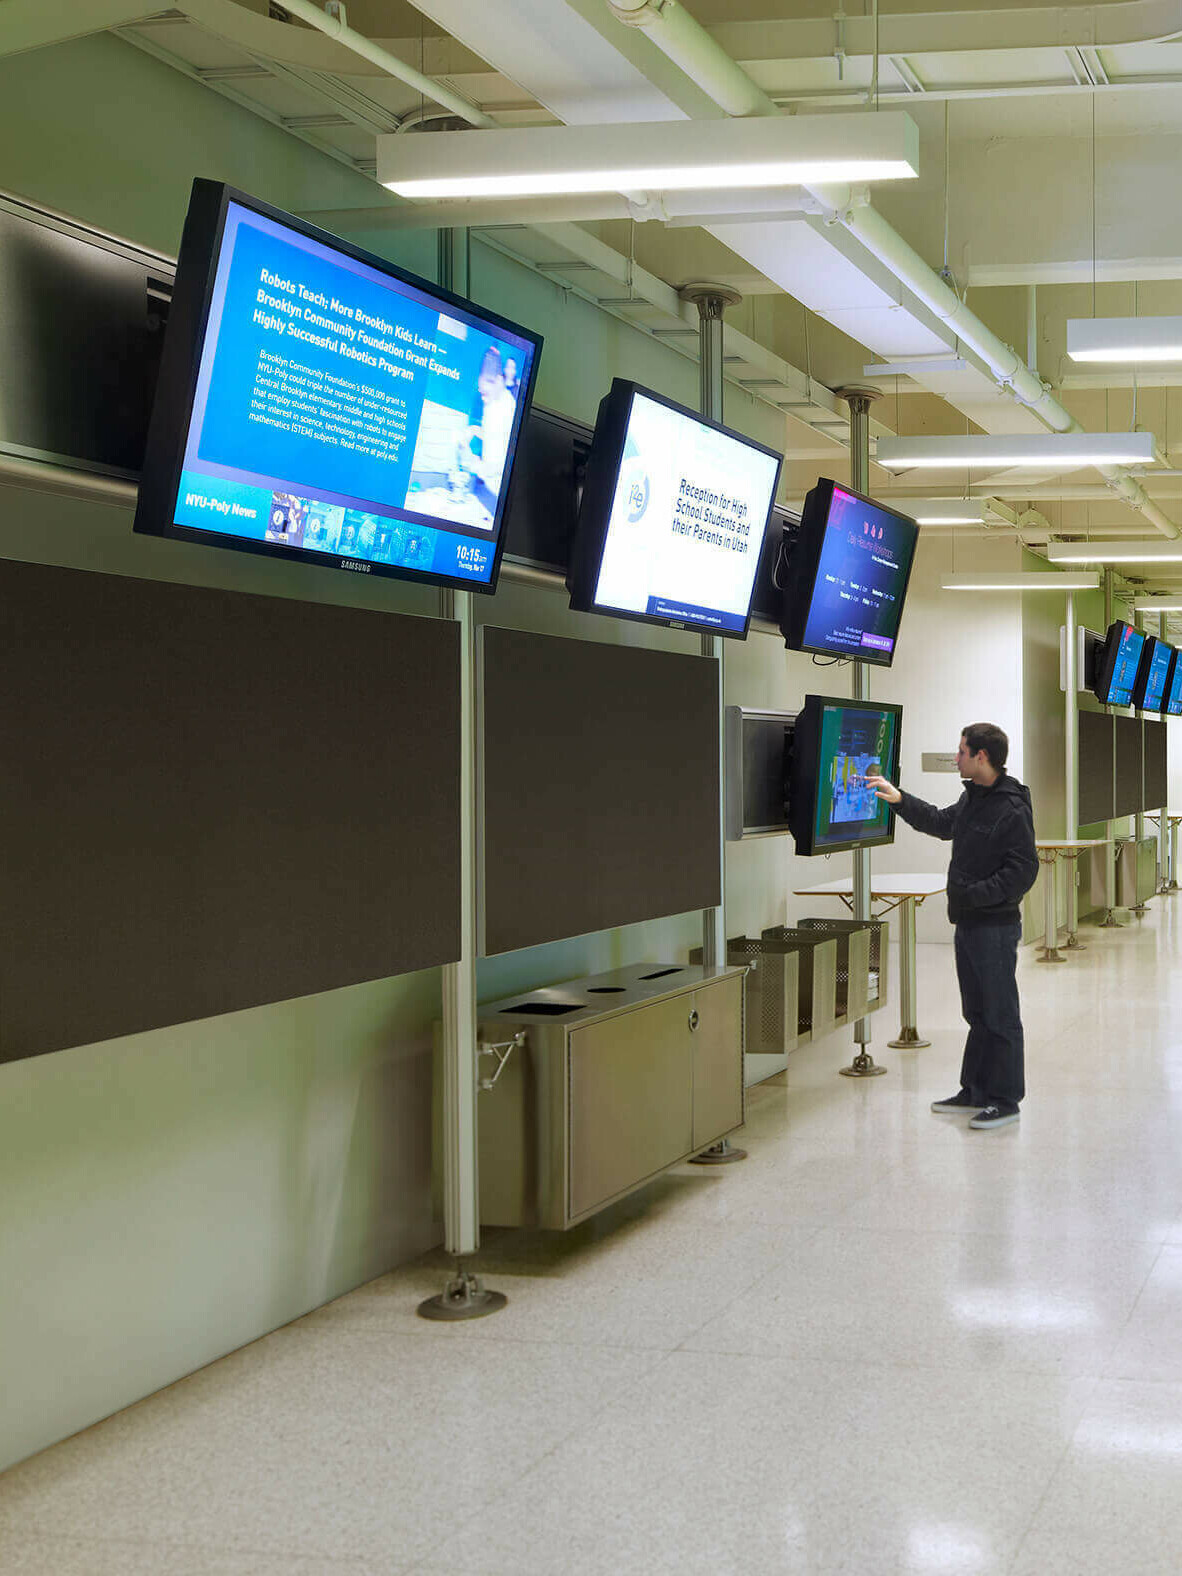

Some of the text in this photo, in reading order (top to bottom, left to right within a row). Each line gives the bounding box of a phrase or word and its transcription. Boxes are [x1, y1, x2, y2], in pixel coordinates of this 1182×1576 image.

[260, 268, 296, 294] Robots
[299, 284, 328, 309] Teach;
[330, 297, 353, 318] More
[355, 308, 393, 335] Brooklyn
[395, 325, 412, 342] Kids
[414, 334, 437, 353] Learn
[253, 308, 414, 381] Highly Successful Robotics Program
[257, 288, 460, 380] Brooklyn Community Foundation Grant Expands
[260, 349, 288, 367] Brooklyn
[289, 360, 324, 380] Community
[256, 374, 280, 389] Central
[281, 383, 308, 399] Brooklyn
[343, 405, 362, 416] middle
[363, 412, 374, 420] and
[374, 414, 385, 424] high
[387, 420, 406, 431] schools
[258, 362, 288, 381] NYU-Poly
[289, 375, 306, 386] could
[307, 380, 323, 392] triple
[324, 385, 333, 394] the
[334, 390, 357, 402] number
[364, 400, 407, 420] under-resourced
[249, 413, 290, 430] mathematics
[341, 438, 355, 449] Read
[355, 444, 369, 453] more
[251, 399, 267, 410] their
[268, 406, 292, 418] interest
[357, 434, 388, 449] engineering
[389, 443, 400, 451] and
[254, 388, 266, 398] that
[268, 393, 291, 407] employ
[320, 408, 350, 424] fascination
[352, 420, 363, 428] with
[364, 423, 380, 433] robots
[382, 428, 387, 436] to
[388, 432, 406, 442] engage
[186, 493, 257, 518] NYU-Poly News
[676, 498, 750, 536] School Students and
[680, 478, 747, 519] Reception for High
[672, 518, 747, 553] their Parents in Utah
[341, 560, 371, 572] SAMSUNG
